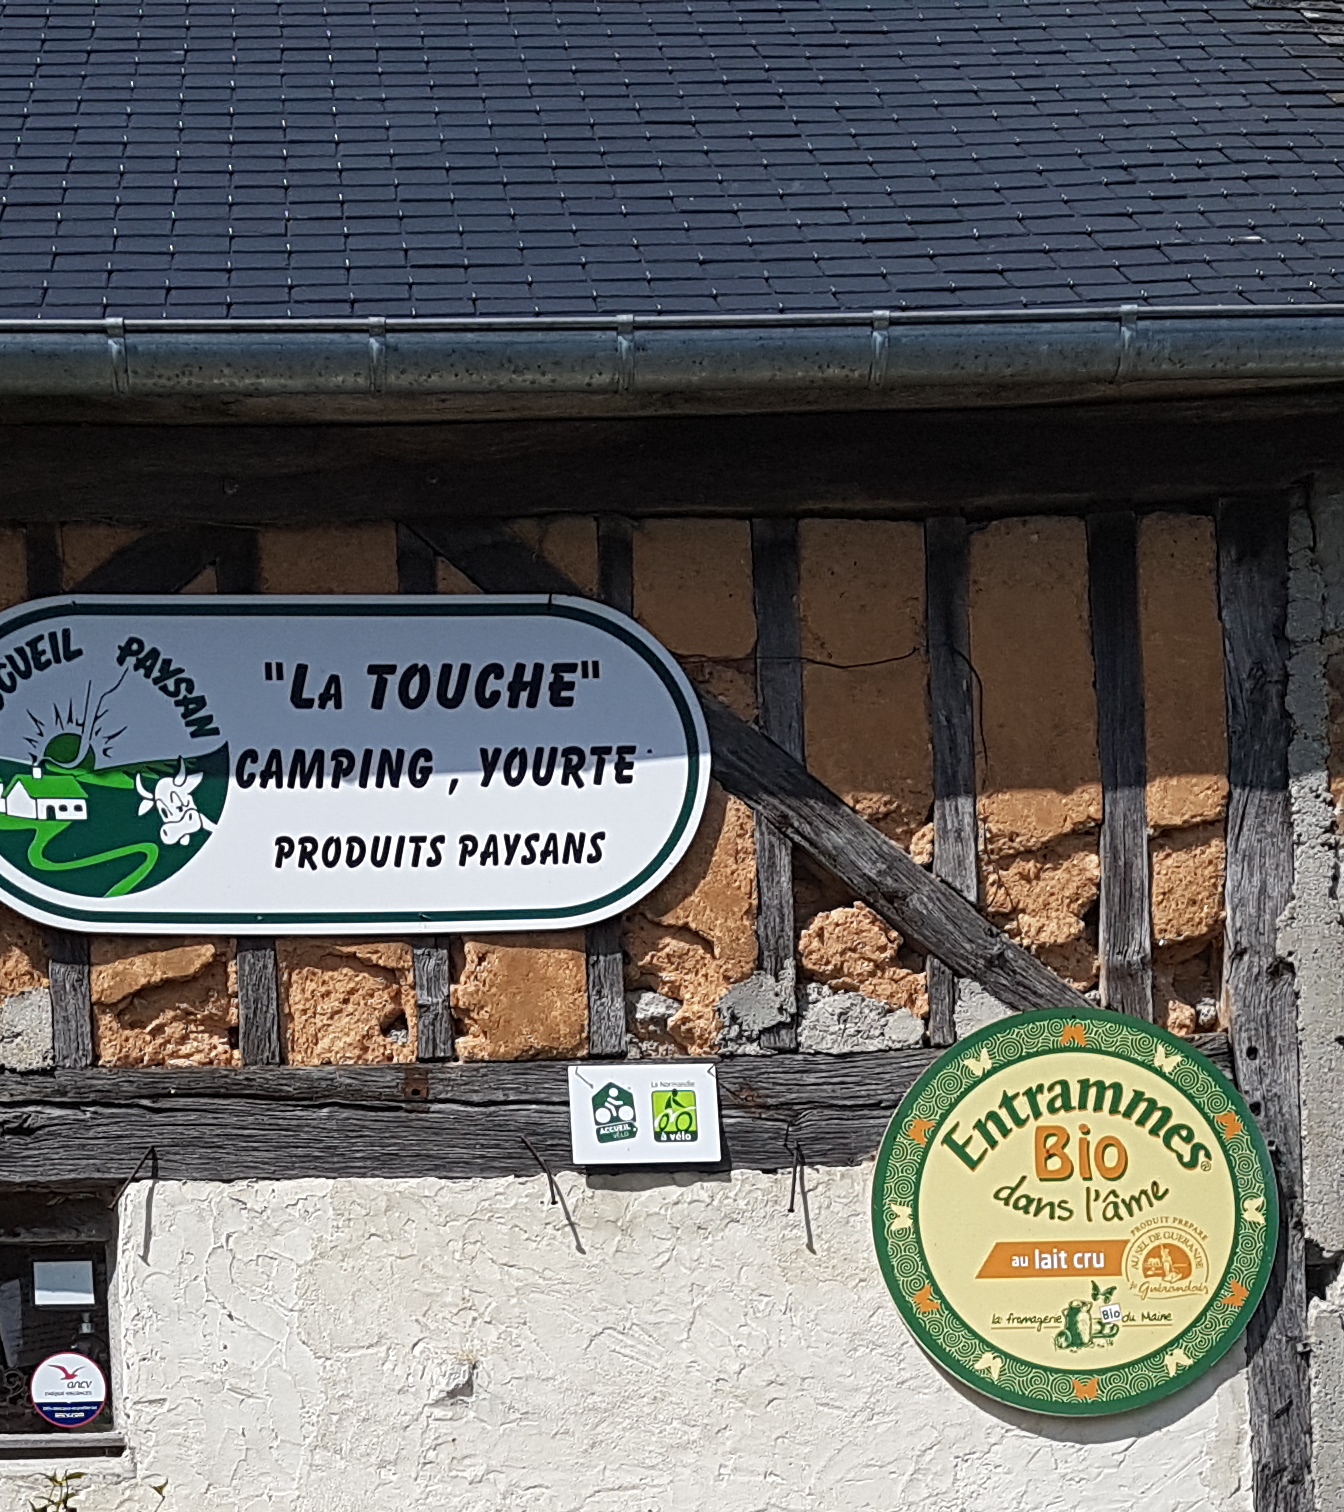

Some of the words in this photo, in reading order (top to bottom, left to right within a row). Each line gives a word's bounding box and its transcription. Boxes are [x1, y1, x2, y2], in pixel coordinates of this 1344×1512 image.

[116, 635, 221, 739] PAYSAN
[367, 660, 601, 710] TOUCHE"
[234, 747, 434, 790] CAMPING
[479, 745, 637, 789] YOURTE
[274, 834, 446, 870] PRODUITS
[457, 831, 606, 868] PAYSANS
[599, 1124, 631, 1135] ACCUEIL
[669, 1130, 692, 1141] vélo
[940, 1077, 1212, 1172] Entrammes
[1034, 1123, 1128, 1182] Bio
[993, 1175, 1075, 1222] dans
[1085, 1180, 1170, 1222] l'âme
[1130, 1216, 1170, 1236] PRODUIT
[1148, 1232, 1162, 1243] DE
[1011, 1256, 1029, 1267] au
[1034, 1249, 1068, 1269] lait
[1073, 1251, 1105, 1269] cru
[1006, 1312, 1062, 1333] fromagerie
[1101, 1308, 1121, 1321] Bio
[1121, 1312, 1136, 1323] du
[1141, 1312, 1173, 1323] Maine
